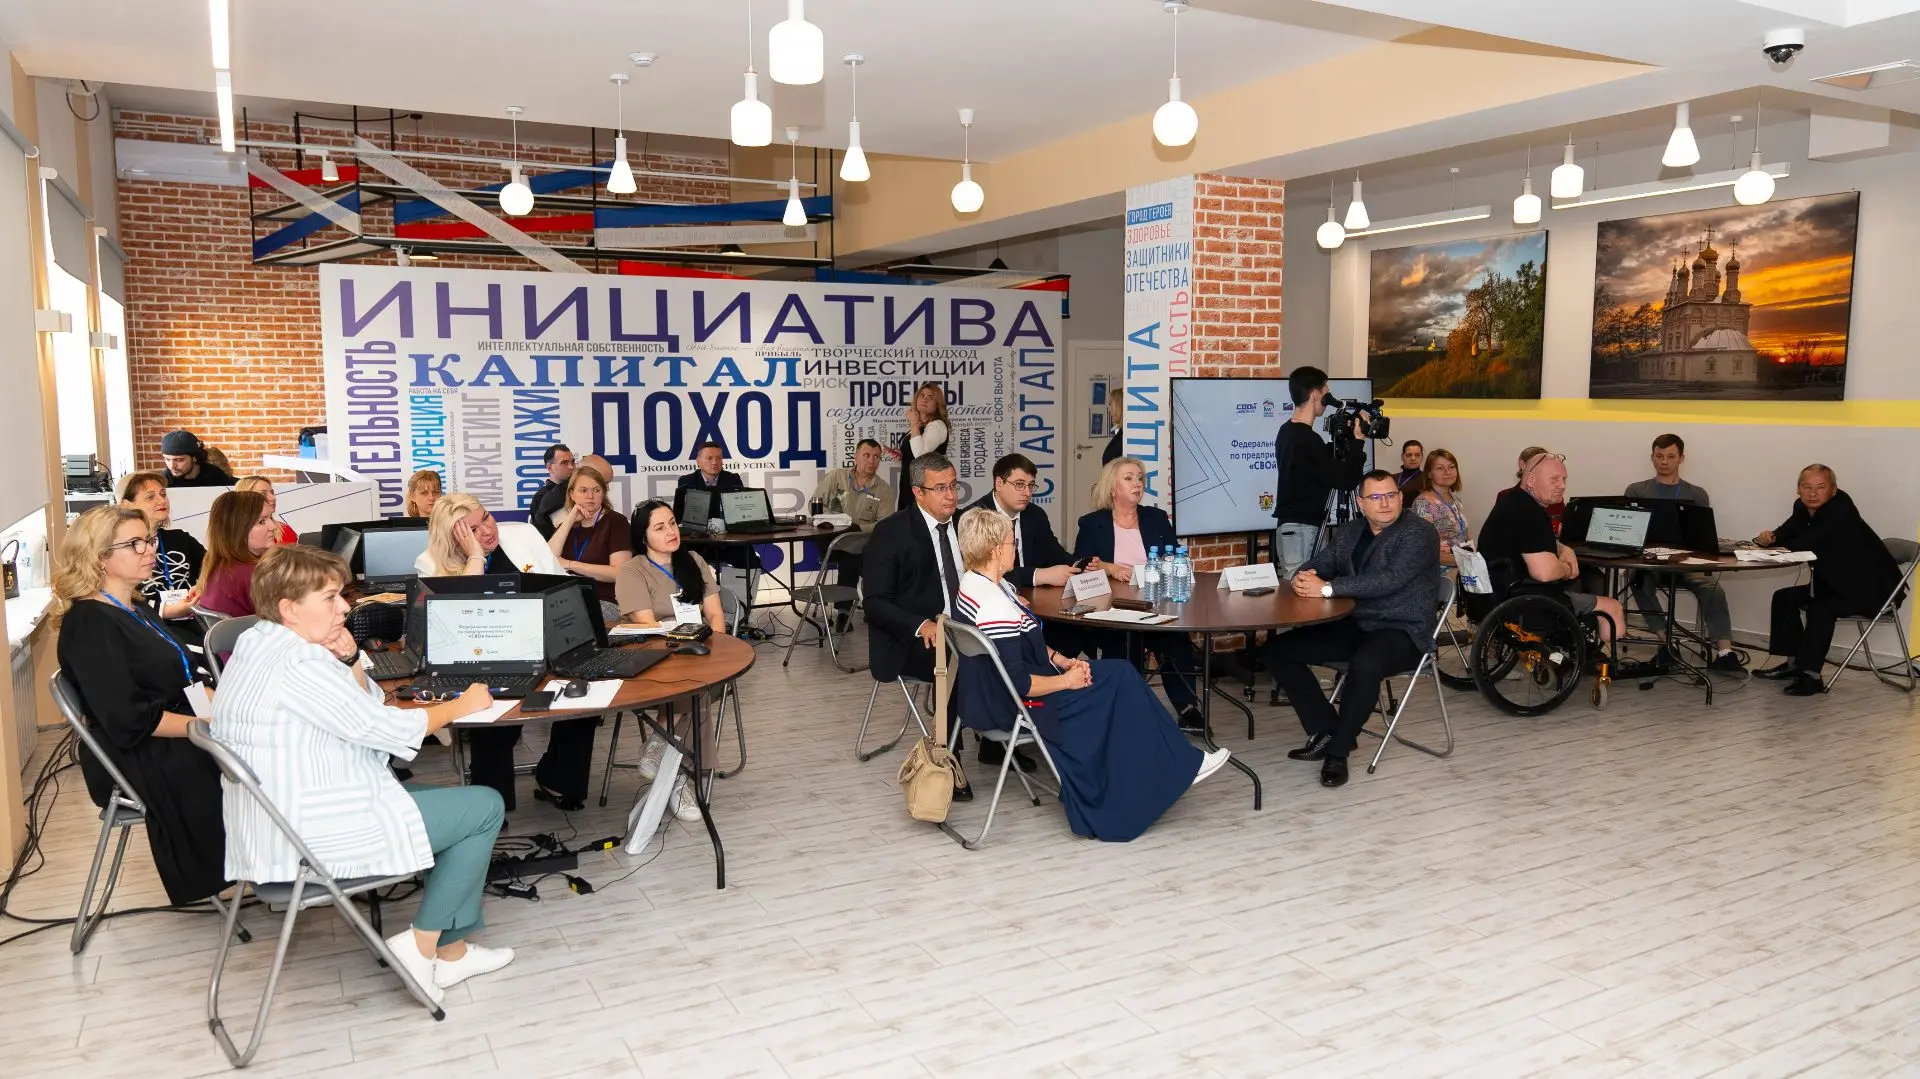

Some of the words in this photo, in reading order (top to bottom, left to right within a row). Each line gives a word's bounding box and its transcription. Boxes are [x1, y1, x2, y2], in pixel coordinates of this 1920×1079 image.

[1129, 208, 1148, 224] ГОРОД
[1149, 203, 1172, 221] ГЕРОЕВ
[1127, 223, 1171, 245] ЗДОРОВЬЕ
[1127, 241, 1190, 268] ЗАЩИТНИКИ
[1126, 267, 1189, 293] ОТЕЧЕСТВА
[340, 278, 1054, 353] ИНИЦИАТИВА
[477, 341, 584, 353] ИНТЕЛЛЕКТУАЛЬНАЯ
[586, 342, 665, 354] СОБСТВЕННОСТЬ
[1168, 291, 1189, 374] ЛАСТЬ
[804, 359, 985, 379] ИНВЕСТИЦИИ
[814, 347, 915, 359] ТВОРЧЕСКИЙ
[919, 349, 978, 361] ПОДХОД
[408, 353, 802, 388] КАПИТАЛ
[803, 377, 849, 389] РИСК
[994, 356, 1003, 391] ВЫСОТА
[826, 405, 905, 425] создание
[994, 392, 1004, 422] СВОЯ
[1127, 321, 1165, 497] АЩИТА
[591, 391, 827, 474] ДОХОД
[1020, 347, 1055, 498] СТАРТАП
[461, 392, 504, 508] МАРКЕТИНГ
[842, 423, 855, 468] Бизнес
[960, 428, 971, 459] БИЗНЕСА
[974, 427, 988, 478] ПРОДАЖИ
[994, 432, 1004, 462] ИЗНЕС
[1241, 452, 1275, 461] предпри
[742, 461, 776, 471] УСПЕХ
[960, 460, 972, 478] ИДЕЯ
